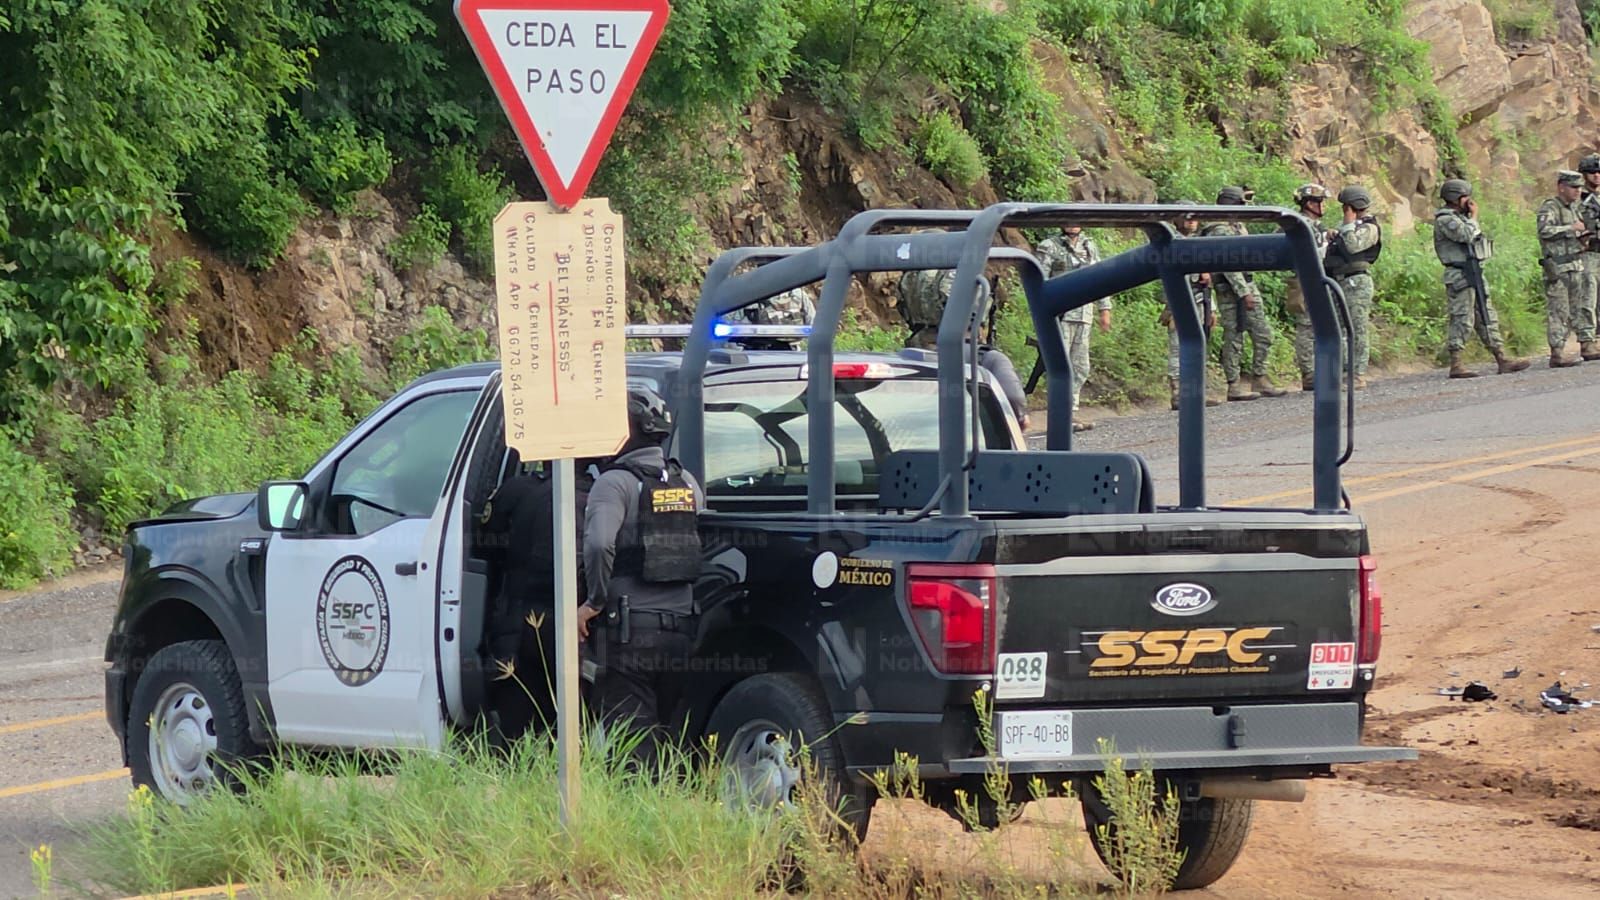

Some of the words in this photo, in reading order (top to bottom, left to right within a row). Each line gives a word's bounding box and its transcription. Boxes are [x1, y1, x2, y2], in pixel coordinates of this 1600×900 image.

[506, 22, 575, 48] CEDA
[595, 24, 627, 48] EL
[527, 69, 606, 94] PASO
[583, 208, 595, 218] Y
[506, 226, 519, 274] WHATS
[523, 211, 536, 272] CALIDAD
[509, 282, 521, 310] APP
[528, 282, 540, 292] Y
[591, 309, 604, 328] EN
[590, 339, 604, 401] GENERAL
[652, 488, 694, 503] SSPC
[840, 558, 882, 568] GOBIERNO
[839, 568, 892, 586] MÉXICO
[1165, 588, 1202, 607] Ford
[331, 602, 376, 619] SSPC
[1090, 628, 1272, 667] SSPC
[1314, 646, 1350, 662] 911
[1001, 656, 1043, 682] 088
[1005, 723, 1070, 745] SPF-40-B8
